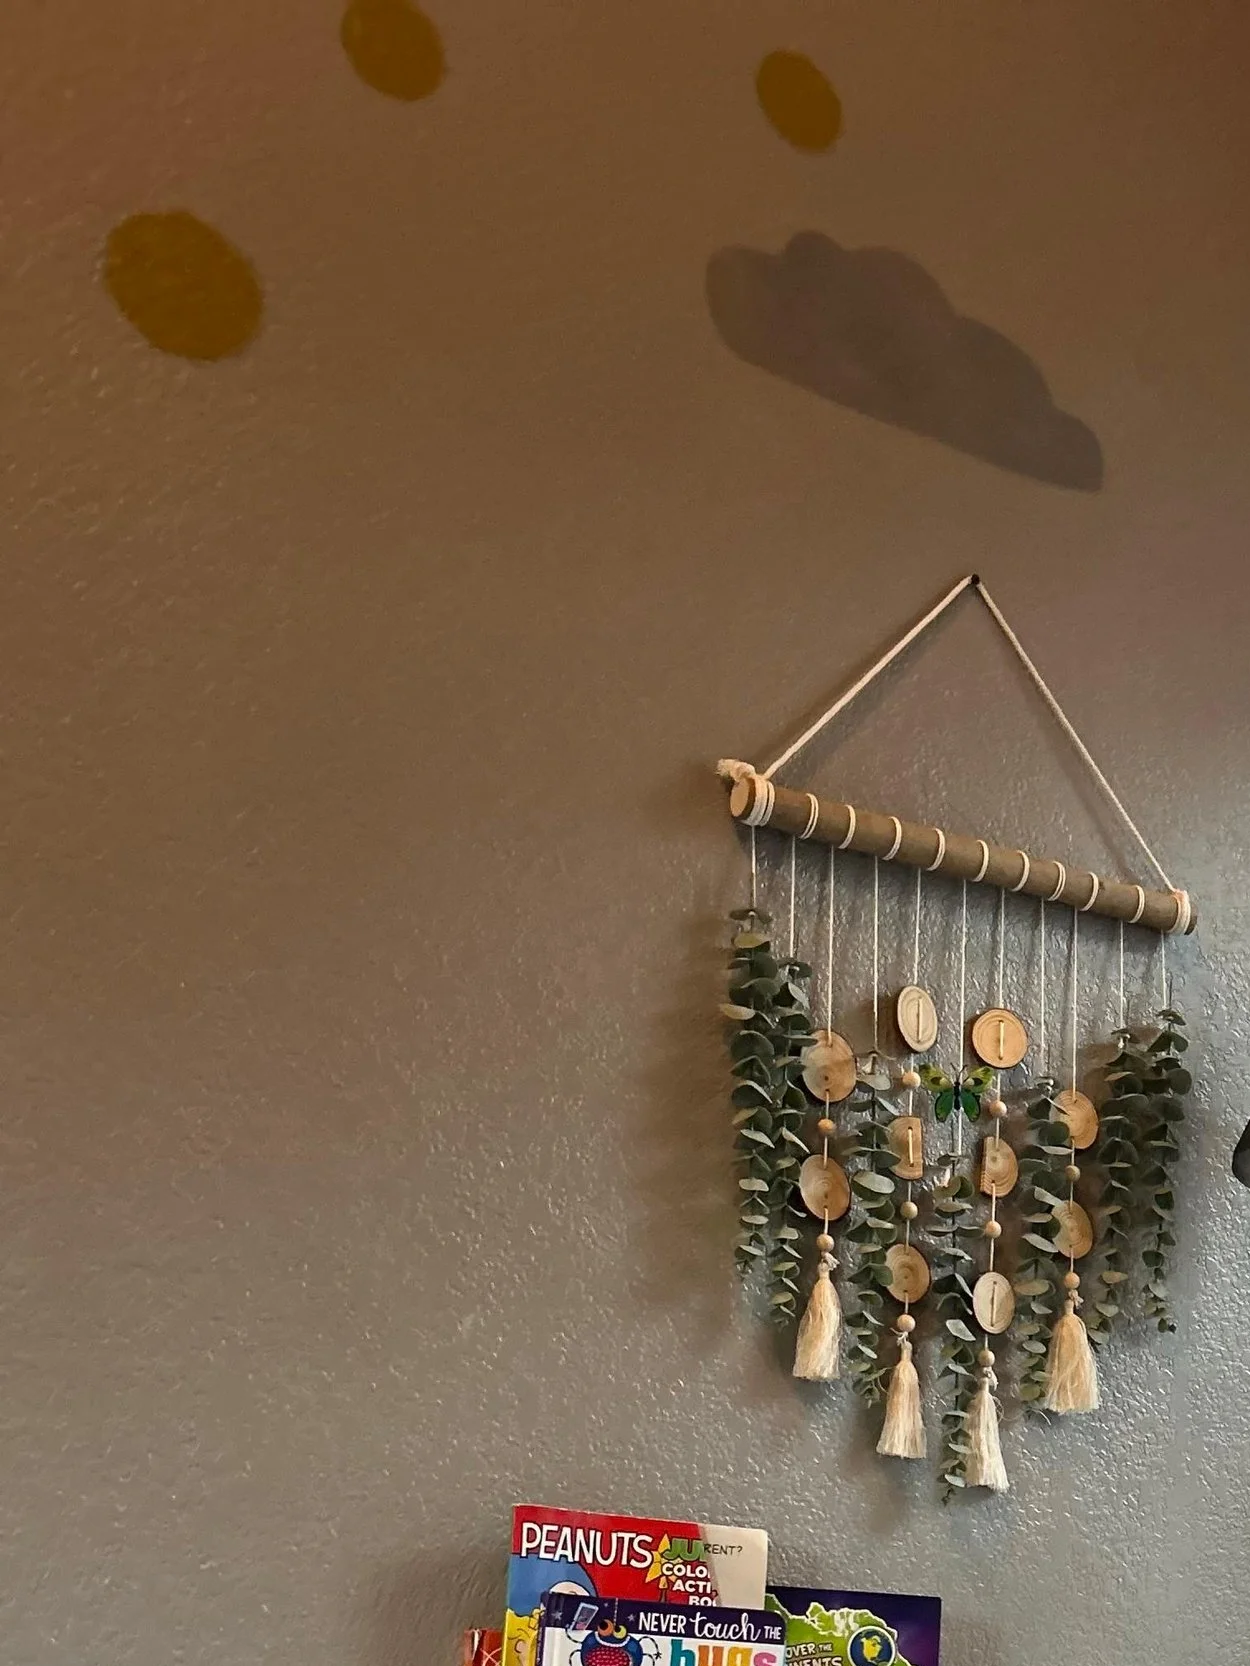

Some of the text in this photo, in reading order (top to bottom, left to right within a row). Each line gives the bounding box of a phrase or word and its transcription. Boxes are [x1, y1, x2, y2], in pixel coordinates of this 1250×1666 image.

[520, 1522, 652, 1569] PEANUTS
[662, 1562, 711, 1578] COLO
[688, 1595, 717, 1607] BO
[638, 1611, 783, 1641] NEVER touch THE
[818, 1643, 833, 1652] THE
